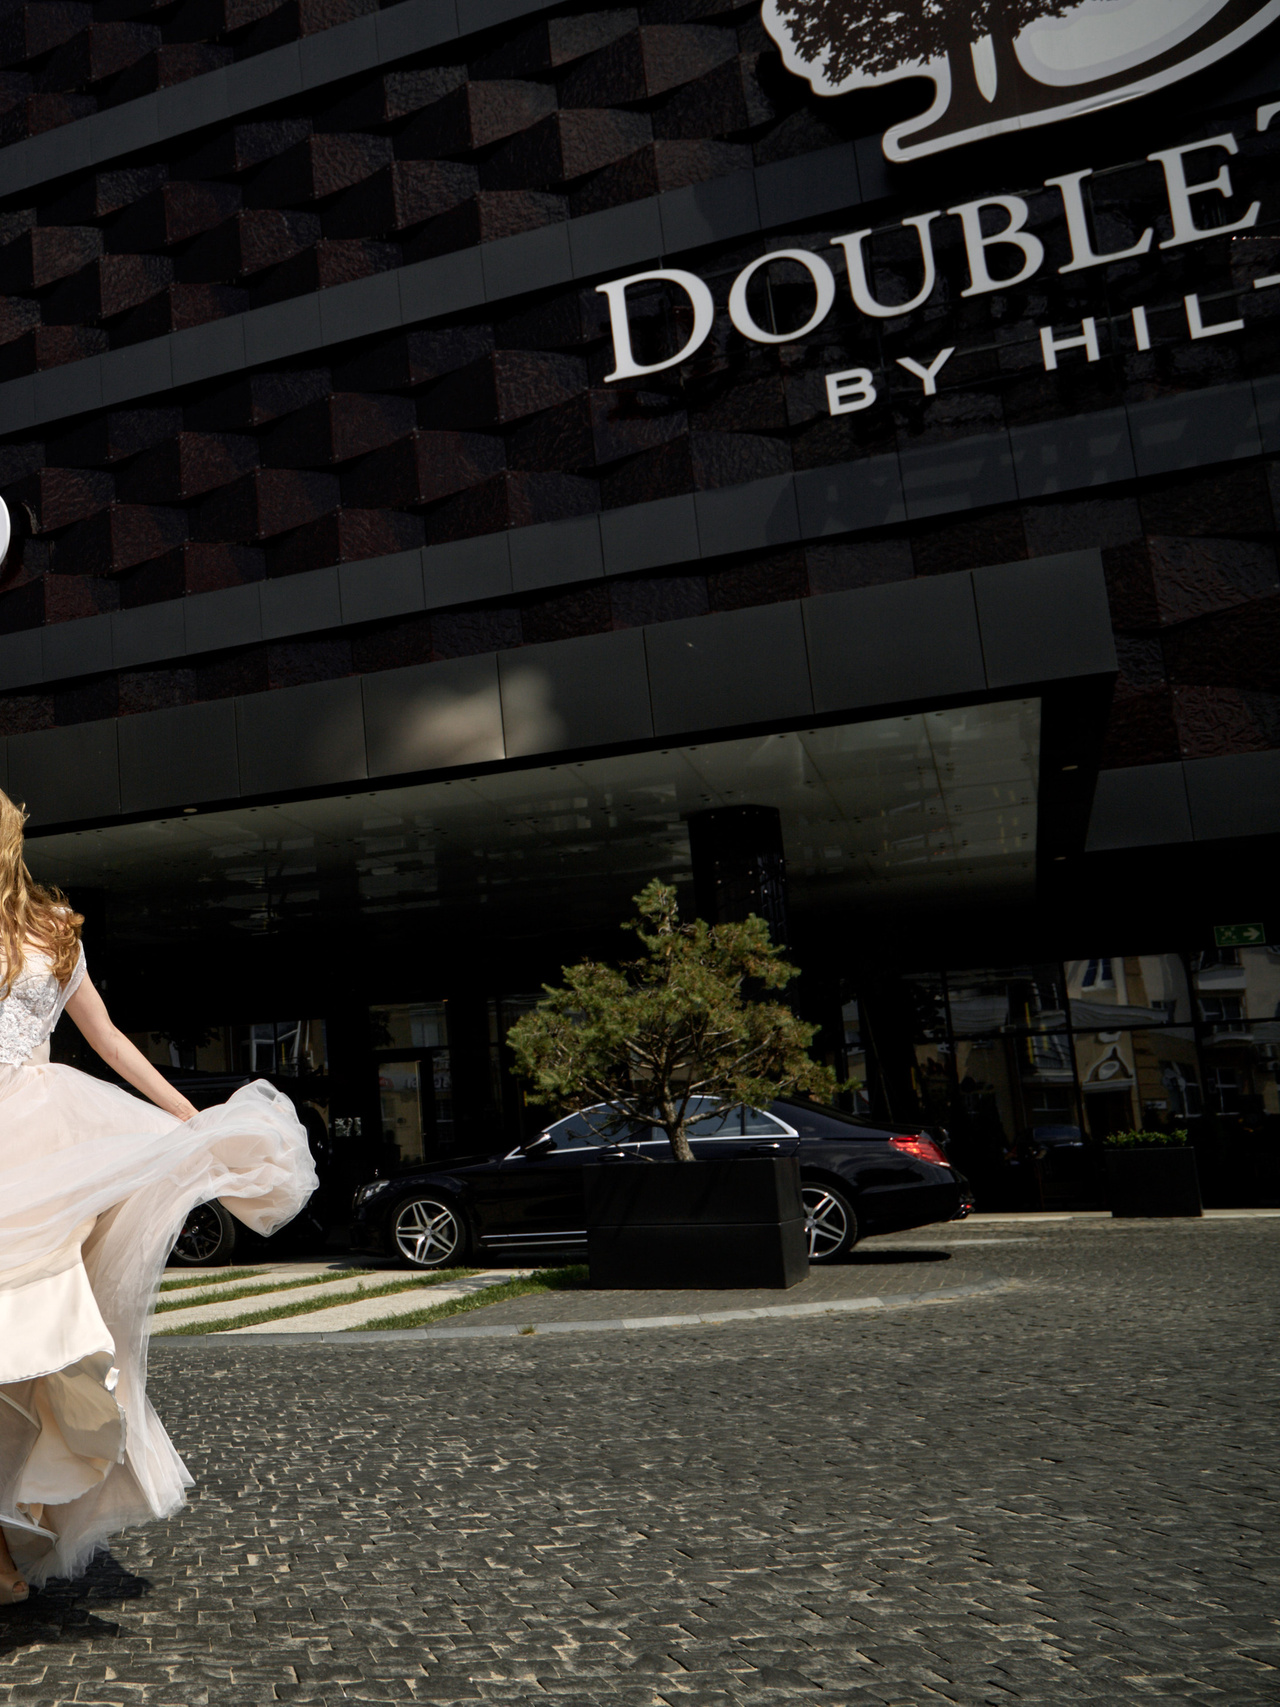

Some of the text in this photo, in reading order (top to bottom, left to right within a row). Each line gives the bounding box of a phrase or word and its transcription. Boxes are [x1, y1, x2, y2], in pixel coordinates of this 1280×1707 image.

[595, 100, 1280, 383] DOUBLE
[825, 274, 1280, 416] BY HIL
